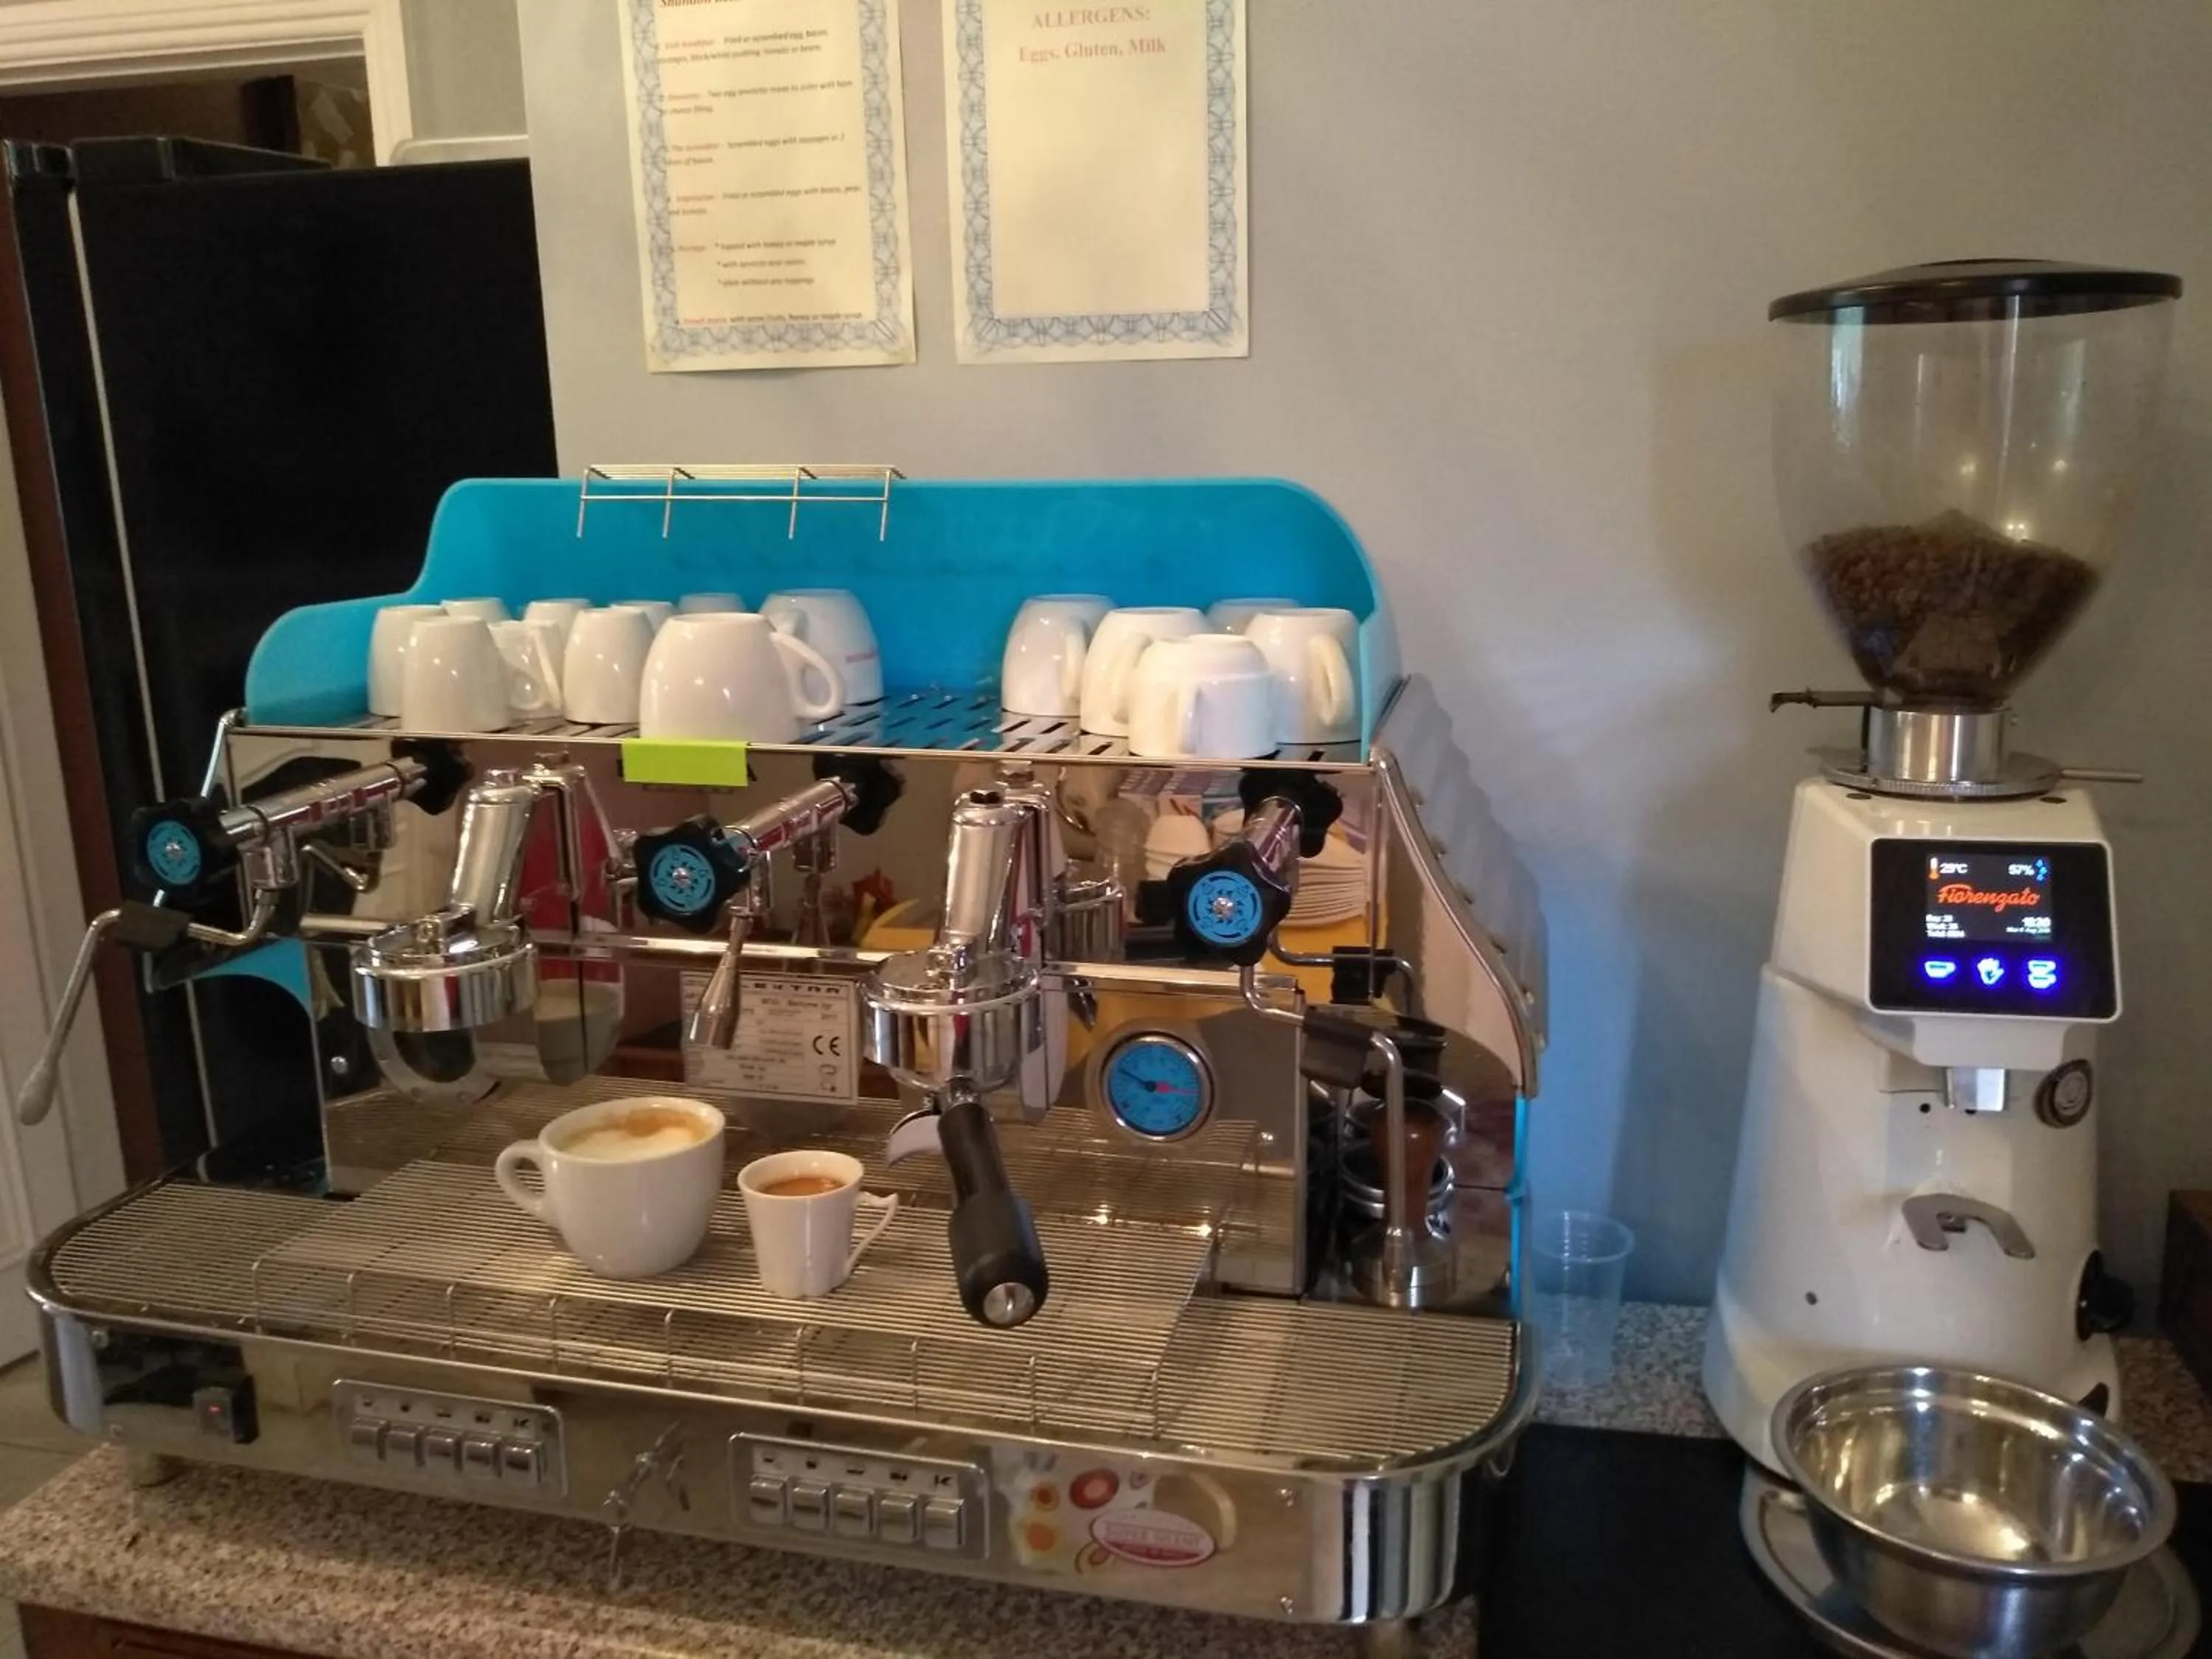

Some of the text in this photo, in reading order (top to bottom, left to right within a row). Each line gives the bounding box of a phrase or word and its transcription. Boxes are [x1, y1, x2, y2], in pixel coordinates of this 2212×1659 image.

[1032, 6, 1150, 29] ALLERGENS:
[1019, 36, 1166, 63] Eggs, Gluten, Milk
